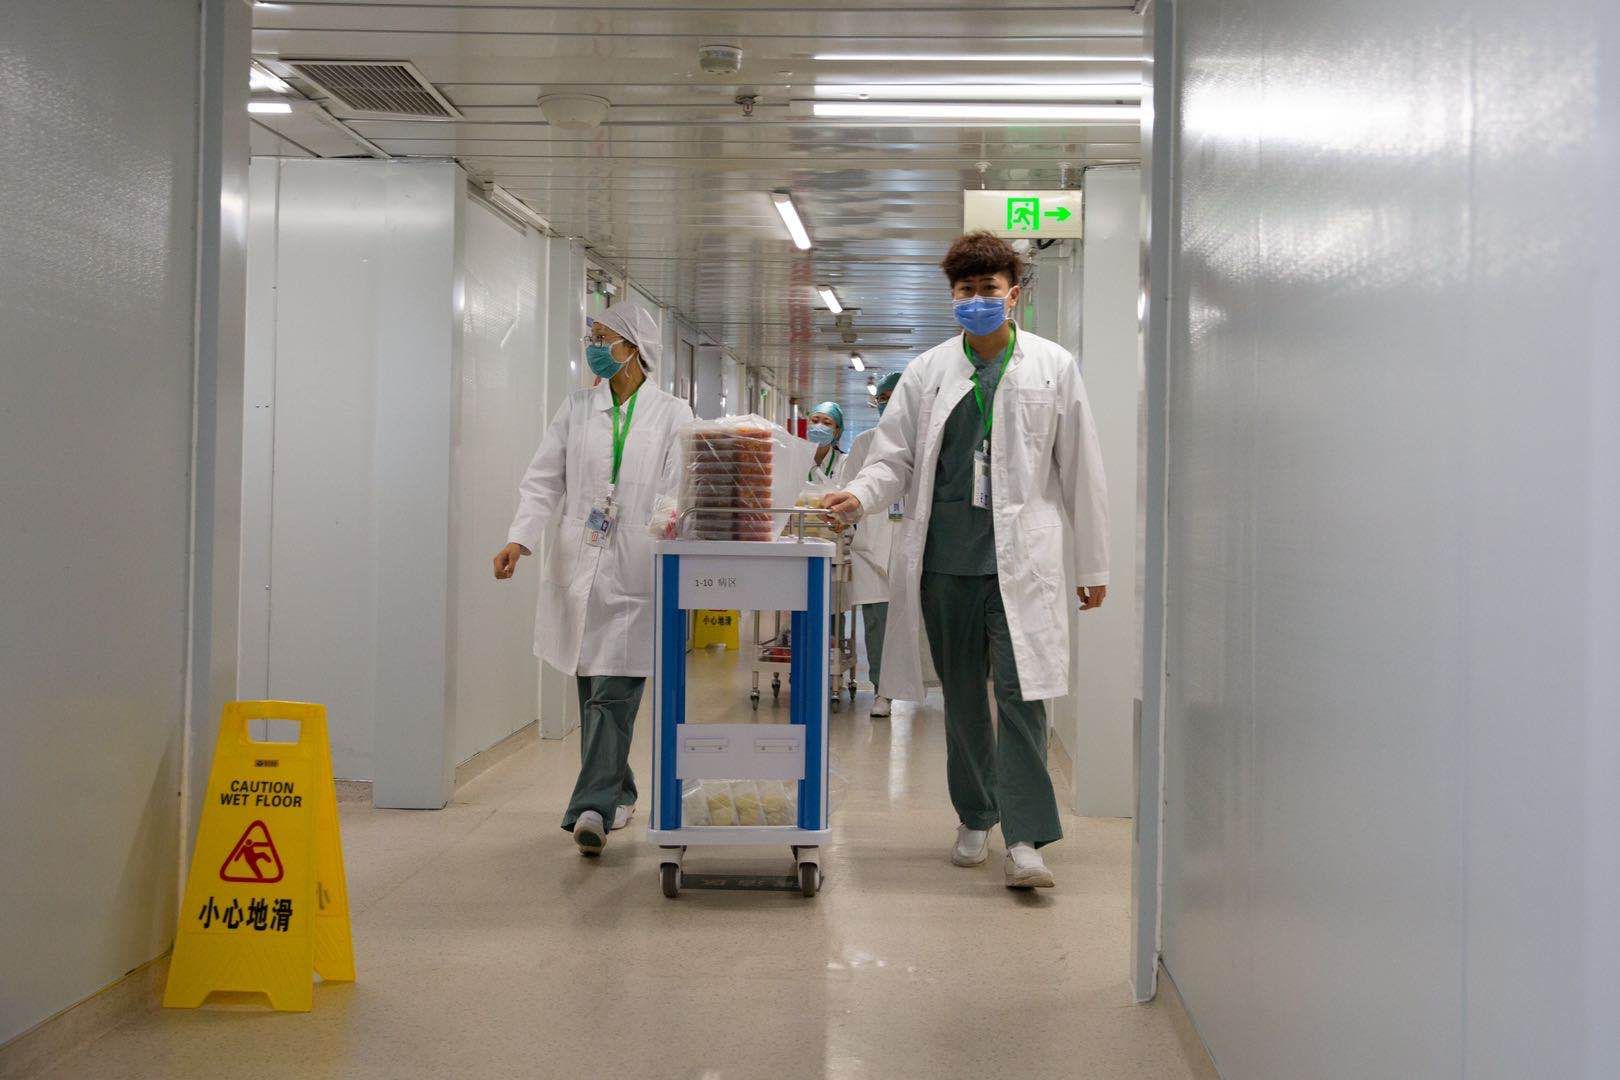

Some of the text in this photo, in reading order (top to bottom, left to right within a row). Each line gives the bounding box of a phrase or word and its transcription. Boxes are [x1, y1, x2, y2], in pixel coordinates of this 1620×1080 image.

[695, 579, 714, 587] 1-10
[703, 615, 732, 626] 小心地滑
[230, 780, 294, 794] CAUTION
[220, 793, 302, 808] WET FLOOR
[198, 896, 293, 932] 小心地滑
